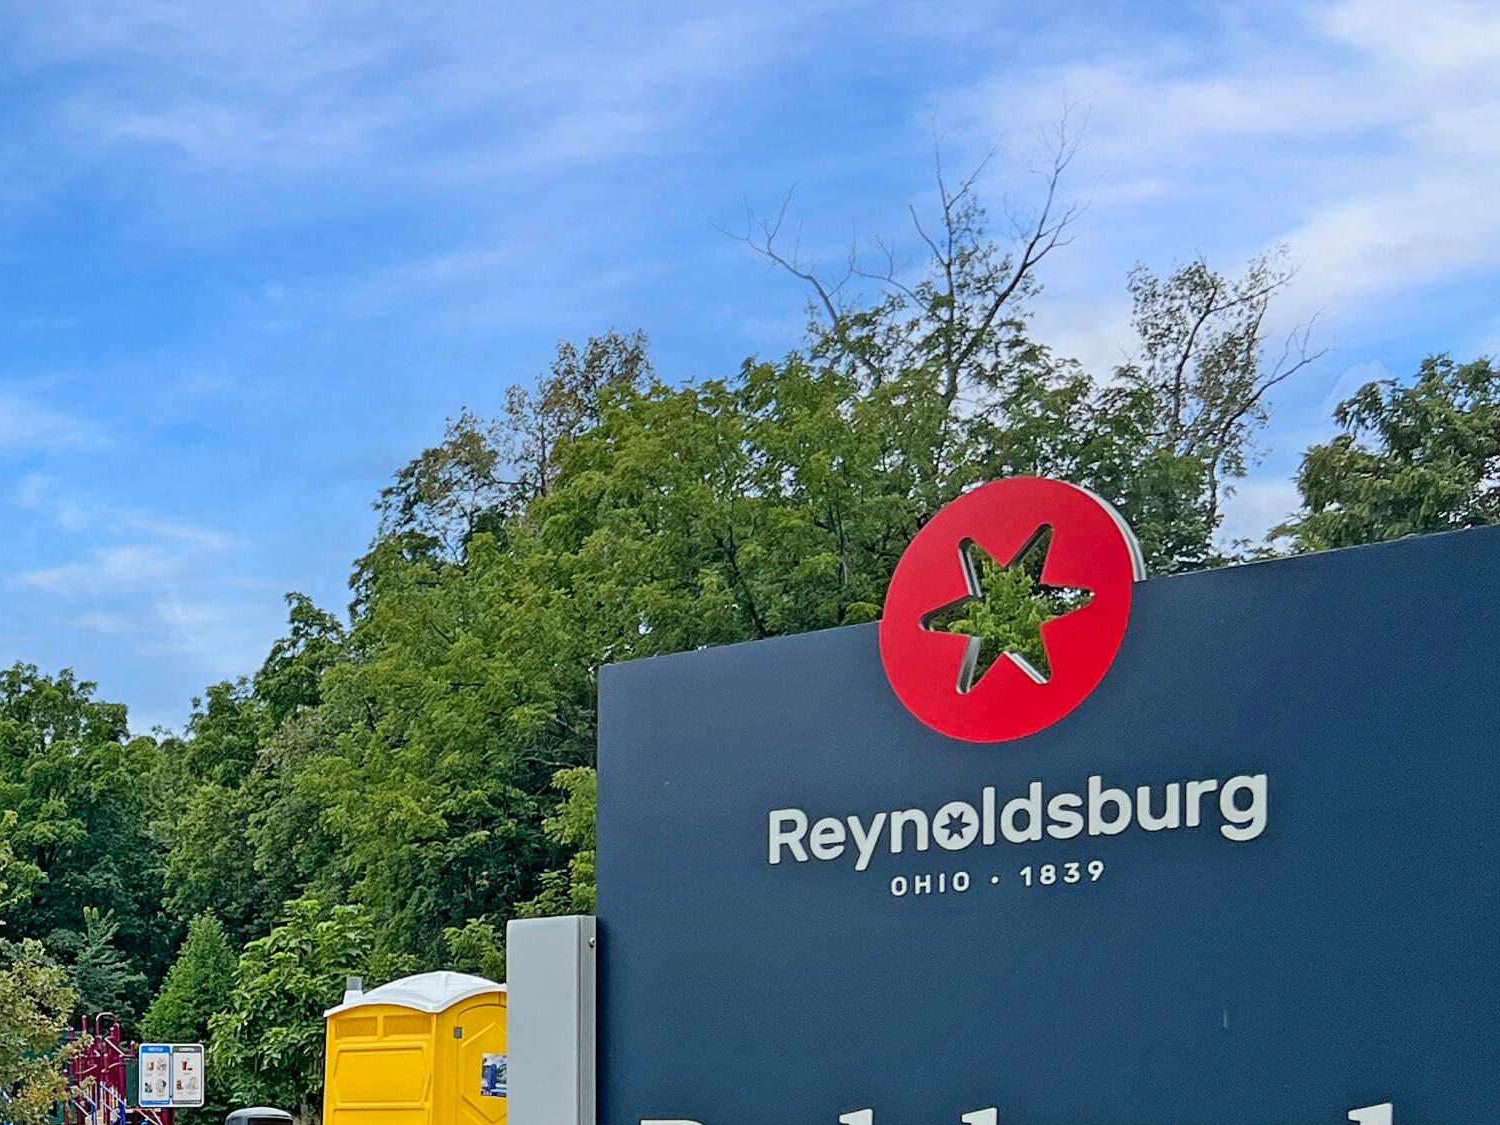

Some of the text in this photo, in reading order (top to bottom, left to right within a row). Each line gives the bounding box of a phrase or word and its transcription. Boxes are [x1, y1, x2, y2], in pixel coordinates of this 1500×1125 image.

[768, 773, 1268, 872] Reynoldsburg
[890, 859, 1105, 897] OHIO 1839
